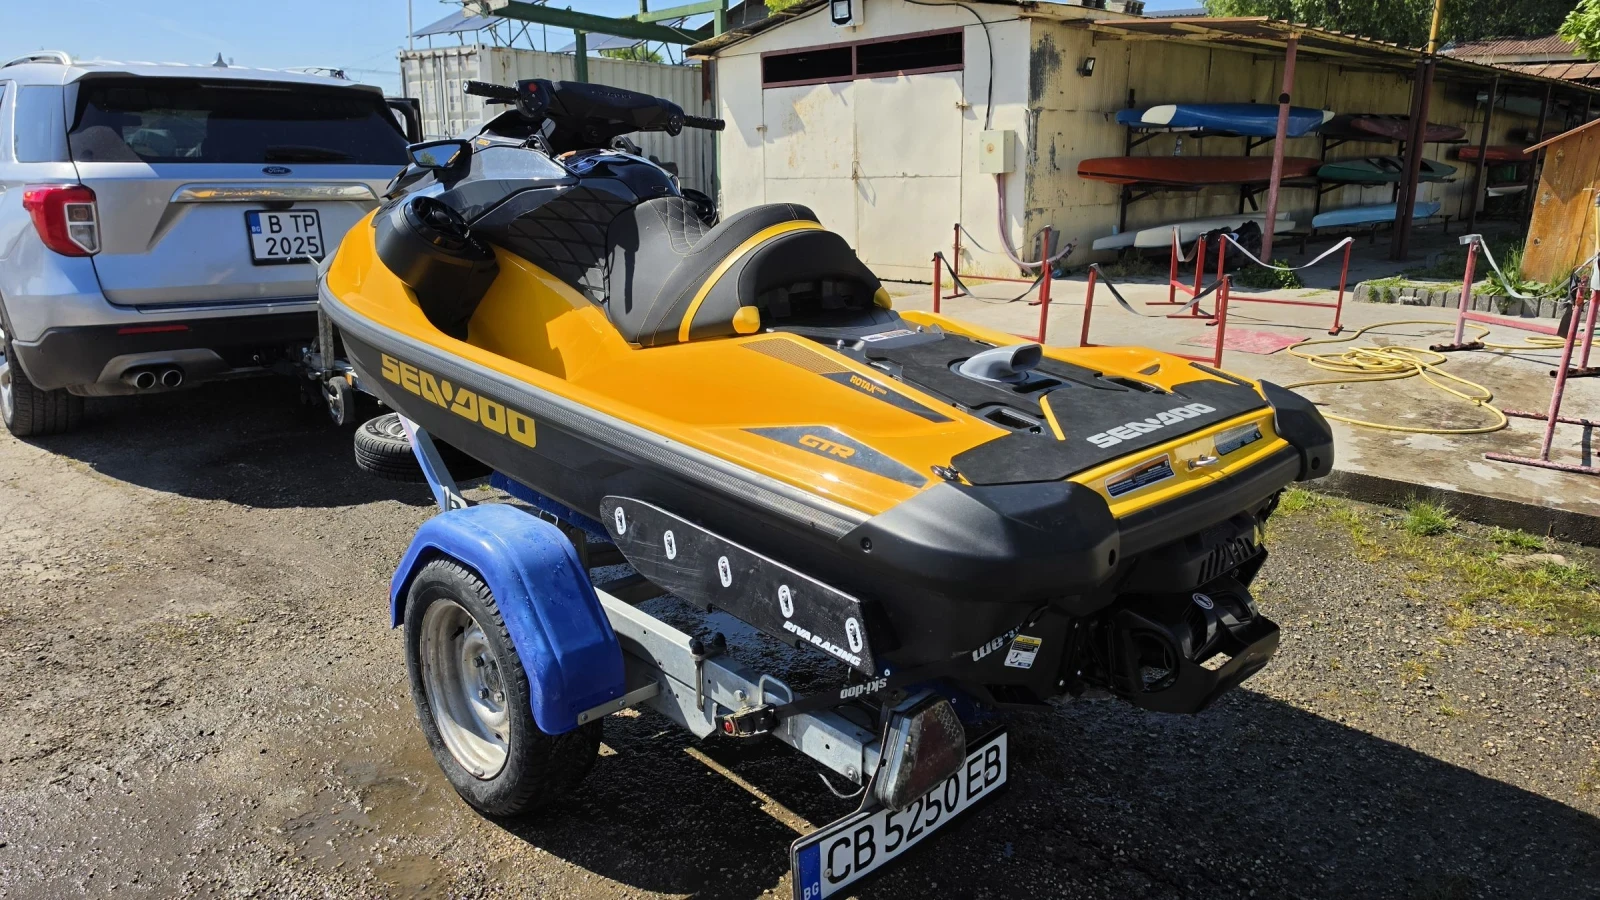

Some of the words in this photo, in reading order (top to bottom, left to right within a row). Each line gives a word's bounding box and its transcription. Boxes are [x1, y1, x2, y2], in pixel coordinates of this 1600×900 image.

[268, 166, 286, 174] Ford
[268, 215, 283, 234] B
[289, 214, 316, 233] TP
[265, 236, 319, 256] 2025
[849, 374, 877, 394] ROTAX
[798, 433, 856, 459] GTR
[783, 620, 811, 641] RIVA
[810, 634, 862, 667] RACING
[826, 824, 876, 884] CB
[885, 772, 960, 853] 5250
[966, 744, 1002, 801] EB
[803, 881, 820, 900] BG
